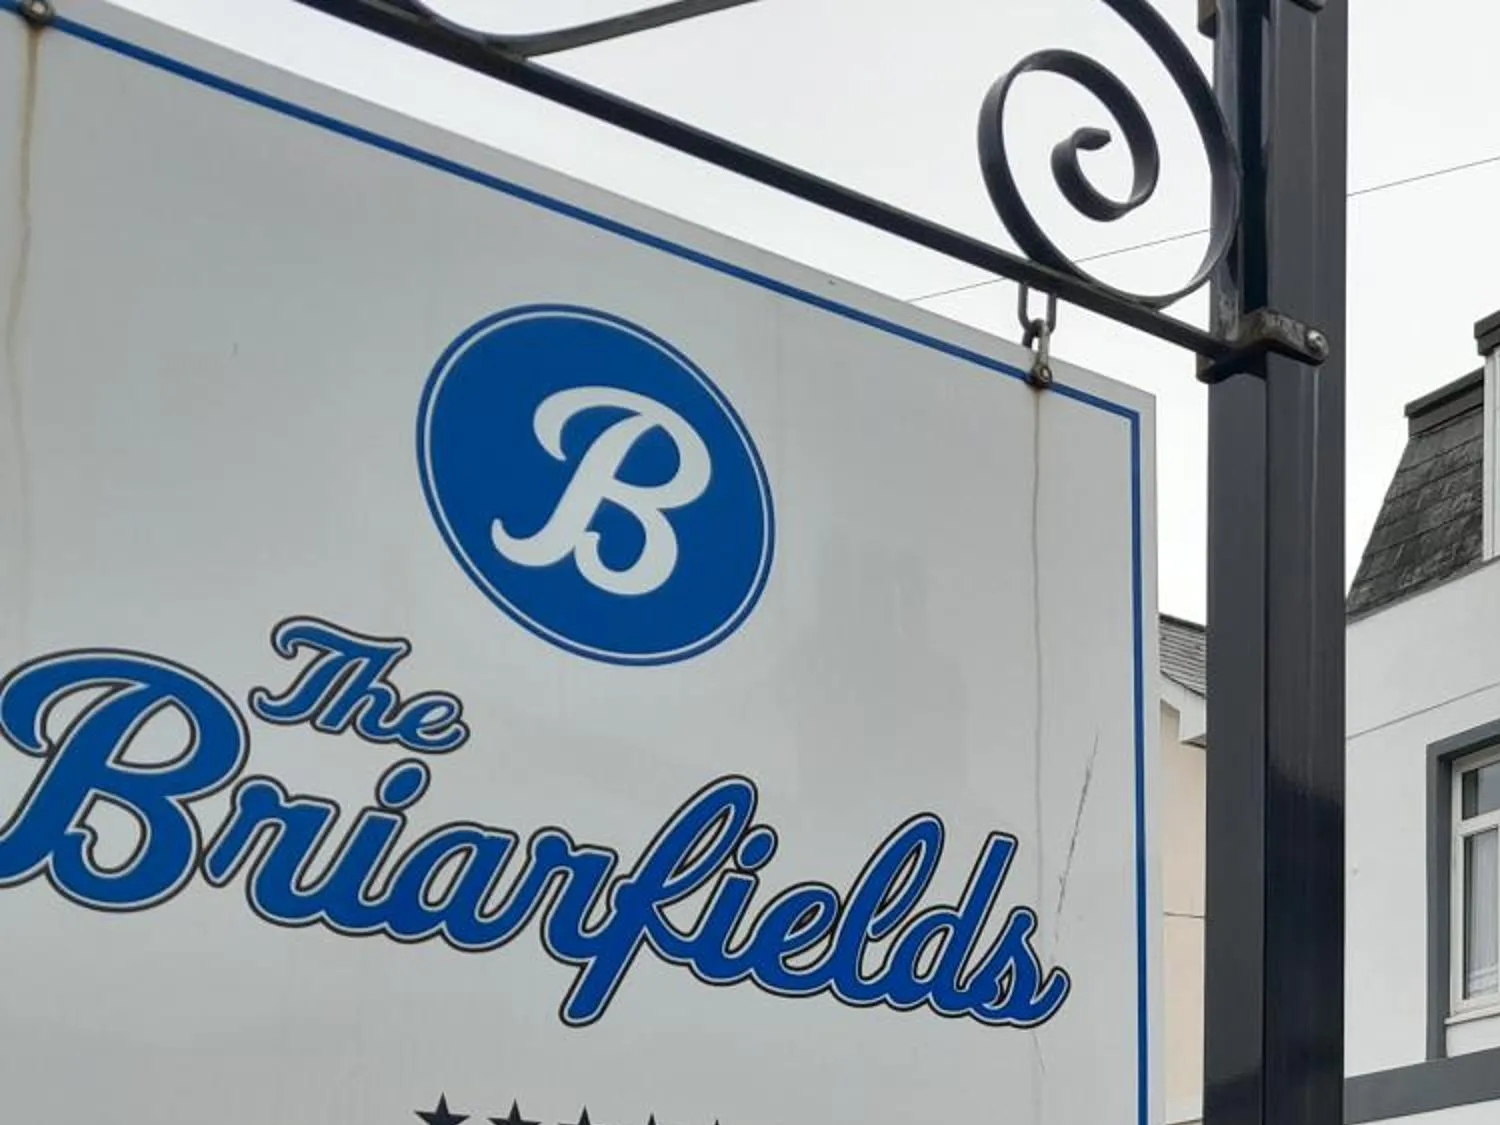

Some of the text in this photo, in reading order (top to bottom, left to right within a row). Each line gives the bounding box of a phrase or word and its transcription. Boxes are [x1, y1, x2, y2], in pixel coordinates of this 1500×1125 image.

[491, 386, 712, 596] B
[249, 616, 470, 754] The
[0, 648, 1071, 1030] Briarfields
